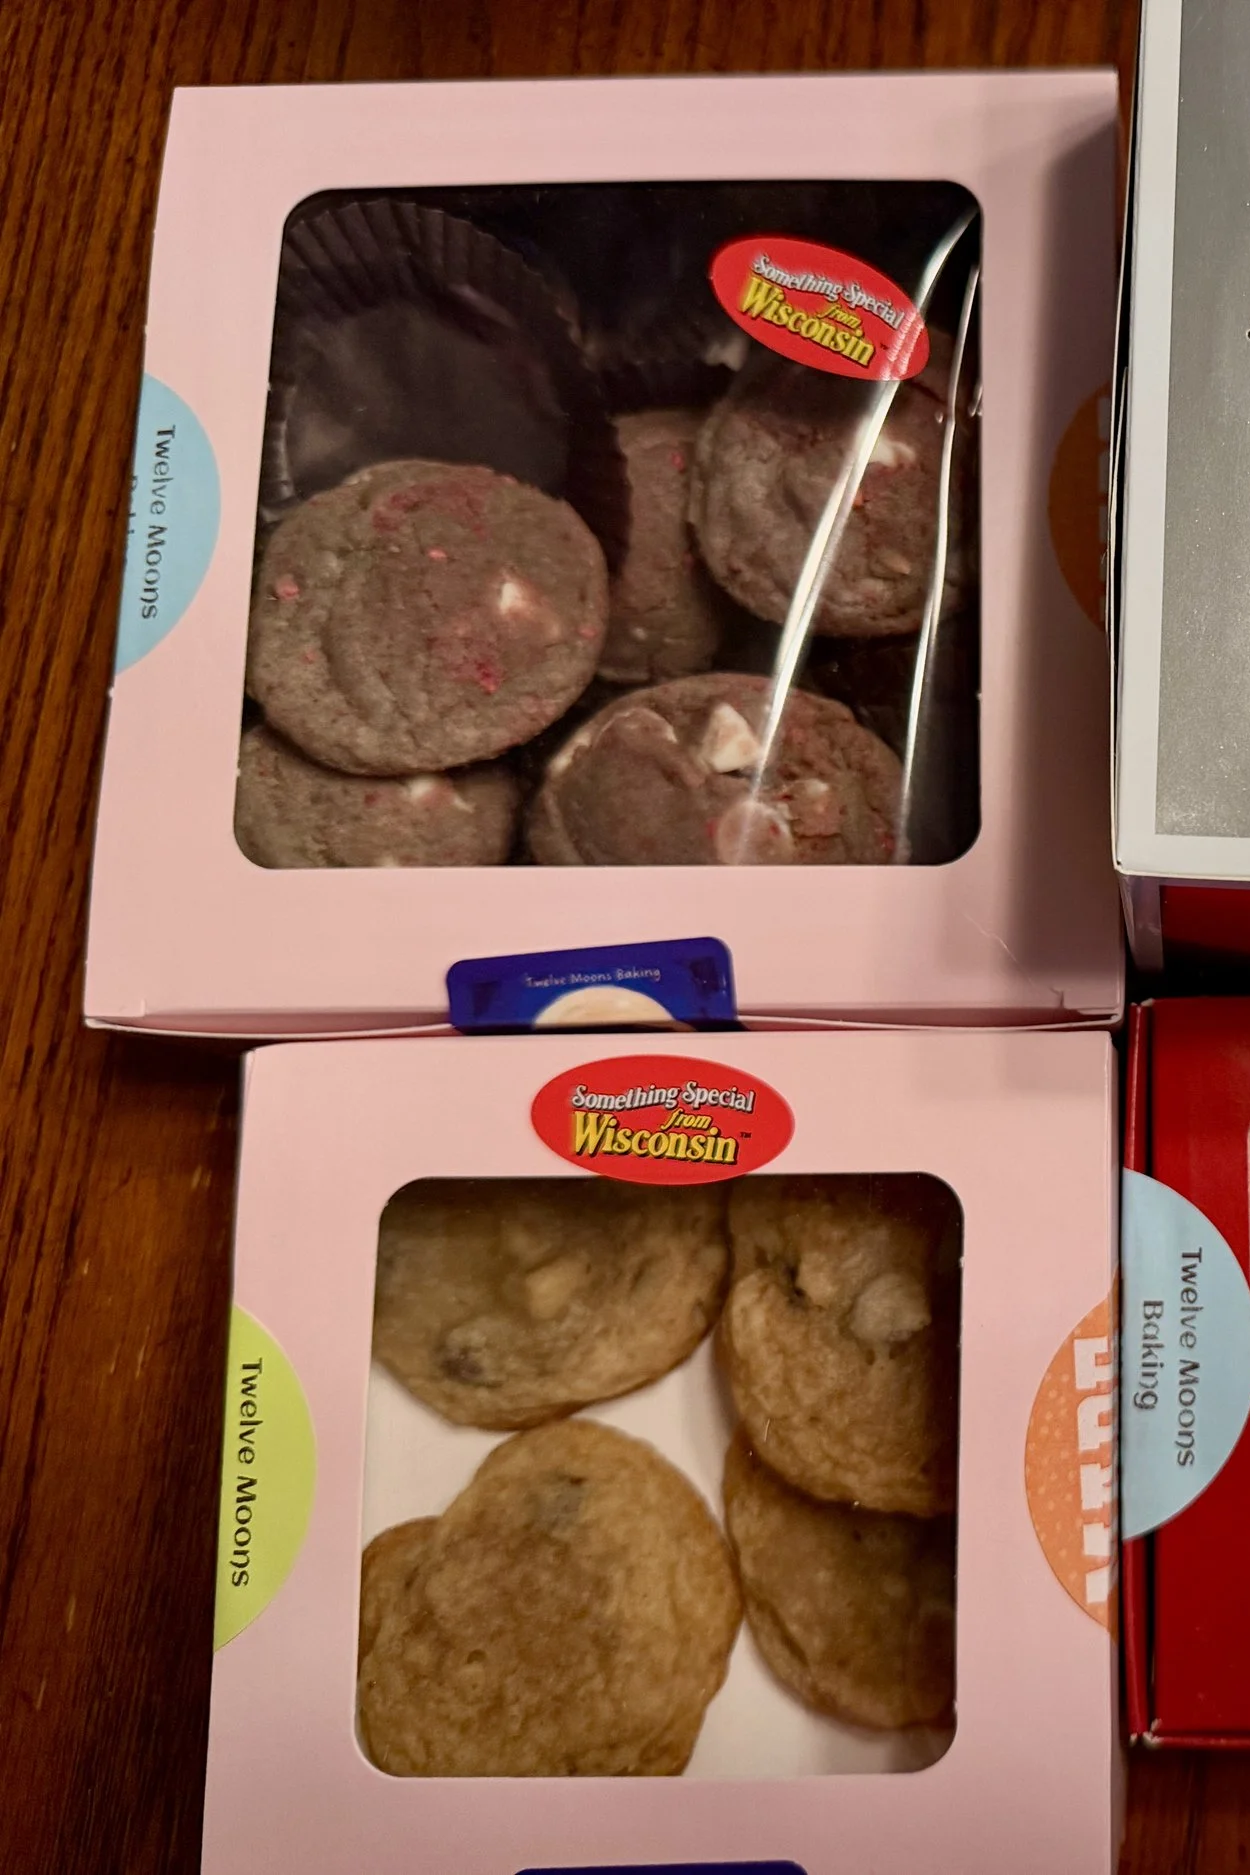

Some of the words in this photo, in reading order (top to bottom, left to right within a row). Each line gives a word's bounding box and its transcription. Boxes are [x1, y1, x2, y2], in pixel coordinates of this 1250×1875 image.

[740, 275, 876, 368] Wisconsin
[751, 253, 844, 303] Something
[841, 284, 904, 330] Special
[816, 304, 862, 330] from
[149, 425, 176, 516] Twelve
[141, 525, 168, 620] Moons
[525, 973, 567, 988] Twelve
[571, 972, 612, 984] Moons
[616, 967, 661, 982] Baking
[571, 1085, 680, 1111] Something
[681, 1080, 755, 1113] Special
[573, 1110, 739, 1165] Wisconsin
[661, 1107, 712, 1131] from
[1178, 1248, 1204, 1349] Twelve
[1133, 1300, 1165, 1411] Baking
[237, 1358, 263, 1464] Twelve
[1176, 1359, 1201, 1467] Moons
[231, 1475, 258, 1587] Moons
